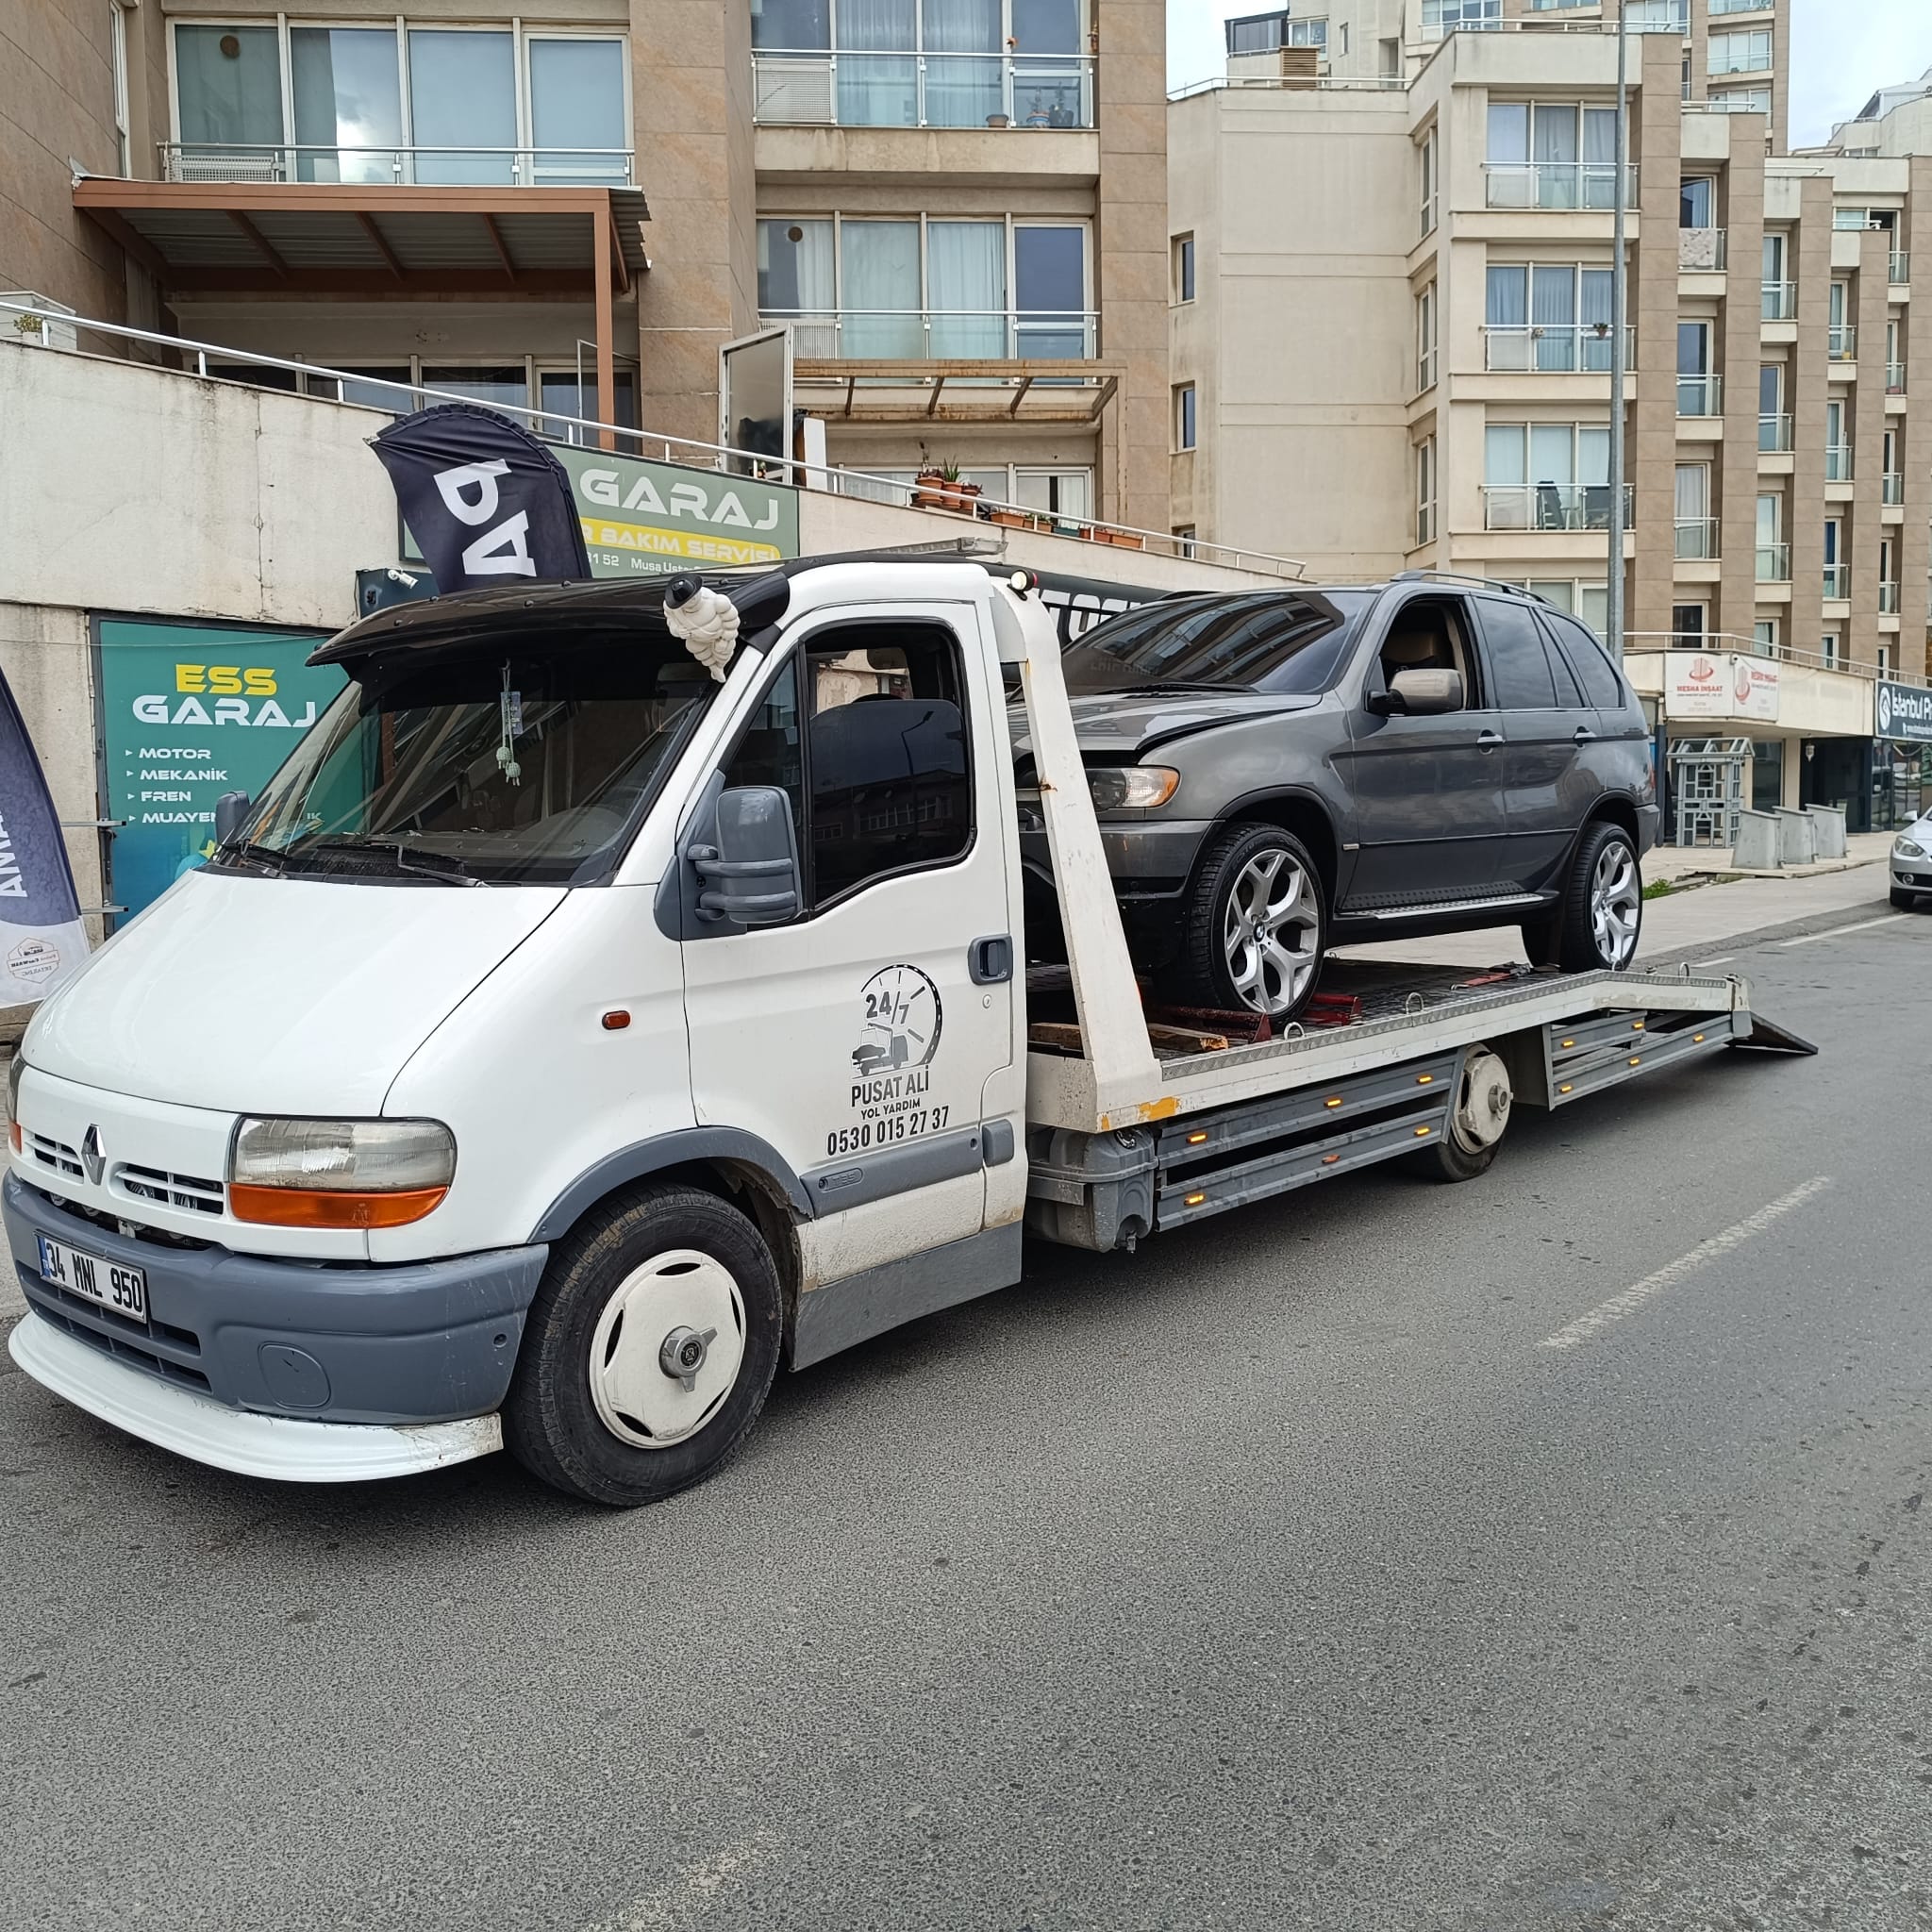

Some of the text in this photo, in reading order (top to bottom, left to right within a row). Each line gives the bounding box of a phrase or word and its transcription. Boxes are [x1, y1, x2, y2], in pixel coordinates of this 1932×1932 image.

[579, 468, 778, 530] GARAJ
[601, 526, 681, 554] BAKIM
[603, 554, 620, 566] 52
[630, 558, 660, 572] Musa
[175, 663, 277, 696] ESS
[132, 694, 316, 727] GARAJ
[139, 748, 211, 759] MOTOR
[140, 767, 228, 780] MEKANİK
[141, 791, 192, 802] FREN
[142, 811, 216, 824] MUAYE
[865, 991, 909, 1024] 24/7
[851, 1064, 929, 1108] PUSAT ALİ
[860, 1097, 921, 1120] YOL YARDIM
[827, 1105, 949, 1157] 0530 015 27 37
[46, 1242, 66, 1282] 34
[72, 1253, 103, 1298] MNL
[110, 1267, 143, 1313] 950
